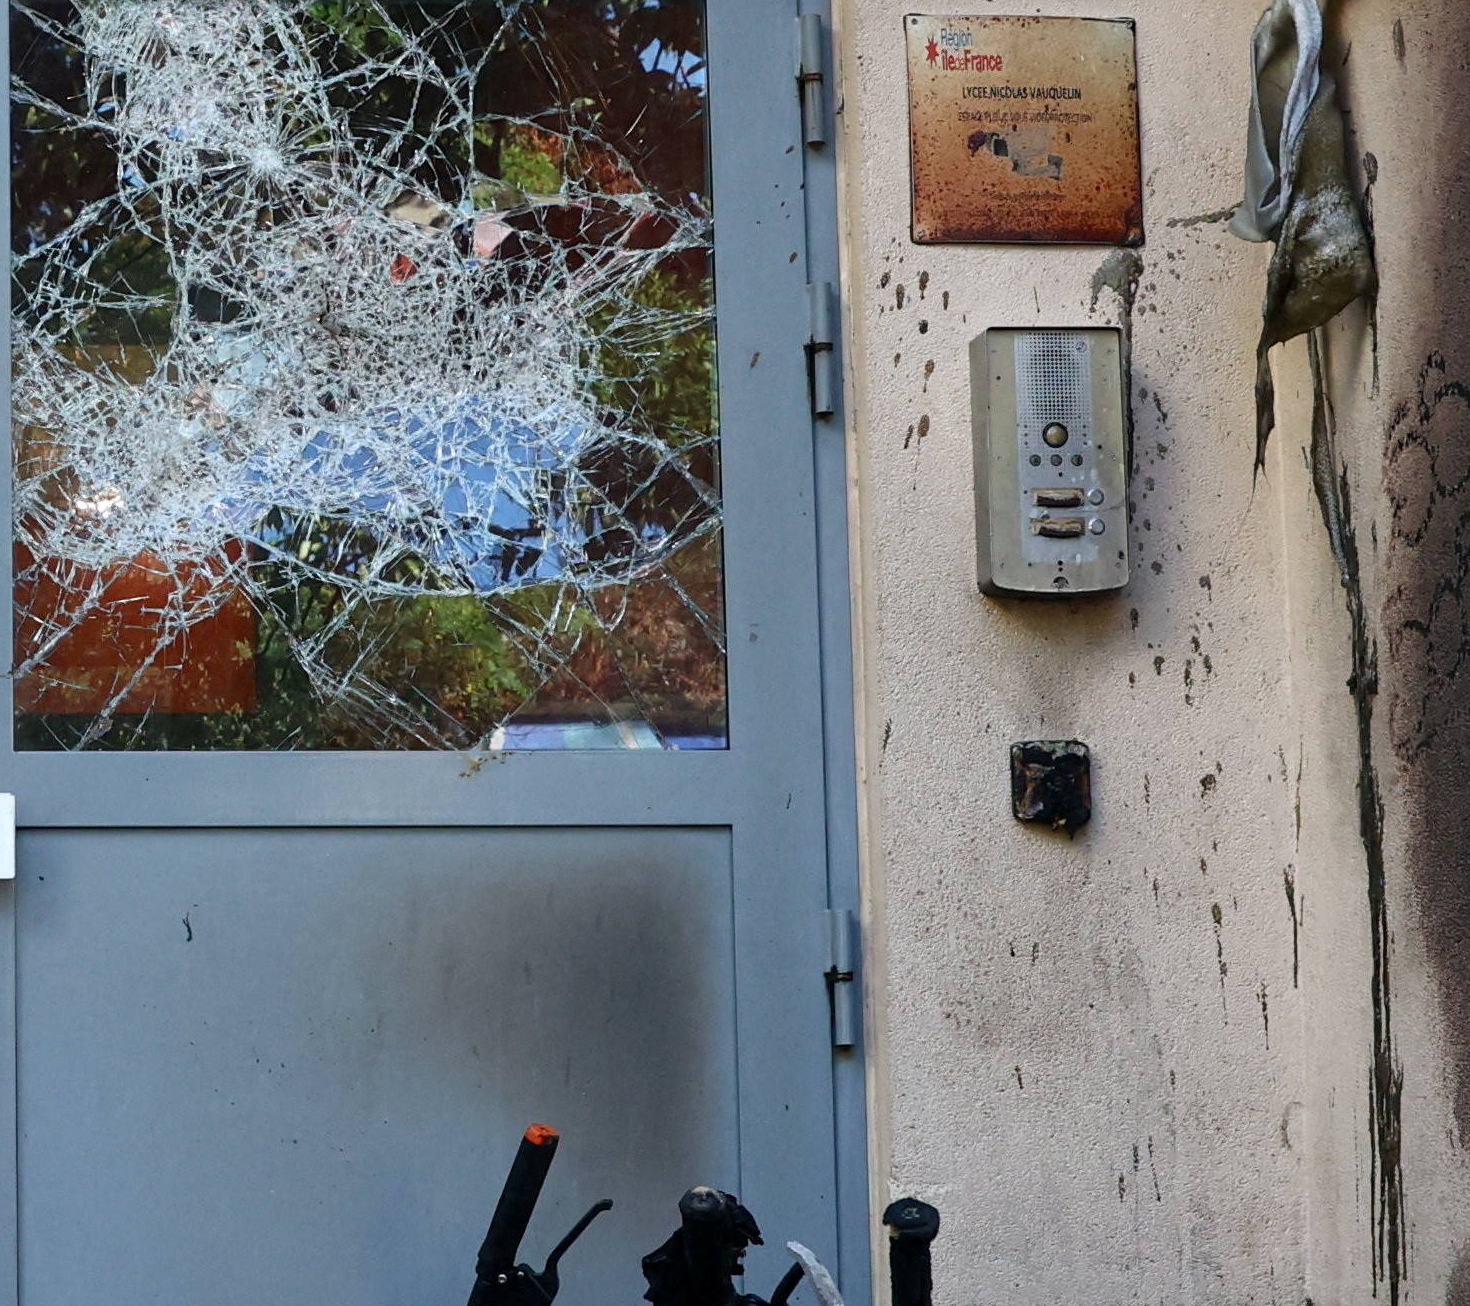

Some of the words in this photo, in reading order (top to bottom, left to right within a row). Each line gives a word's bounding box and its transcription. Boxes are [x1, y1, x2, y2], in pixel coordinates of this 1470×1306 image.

[940, 28, 973, 50] Région
[962, 86, 987, 99] LYCEE
[990, 86, 1028, 99] NICOLAS
[1030, 86, 1081, 100] VAUQUELIN
